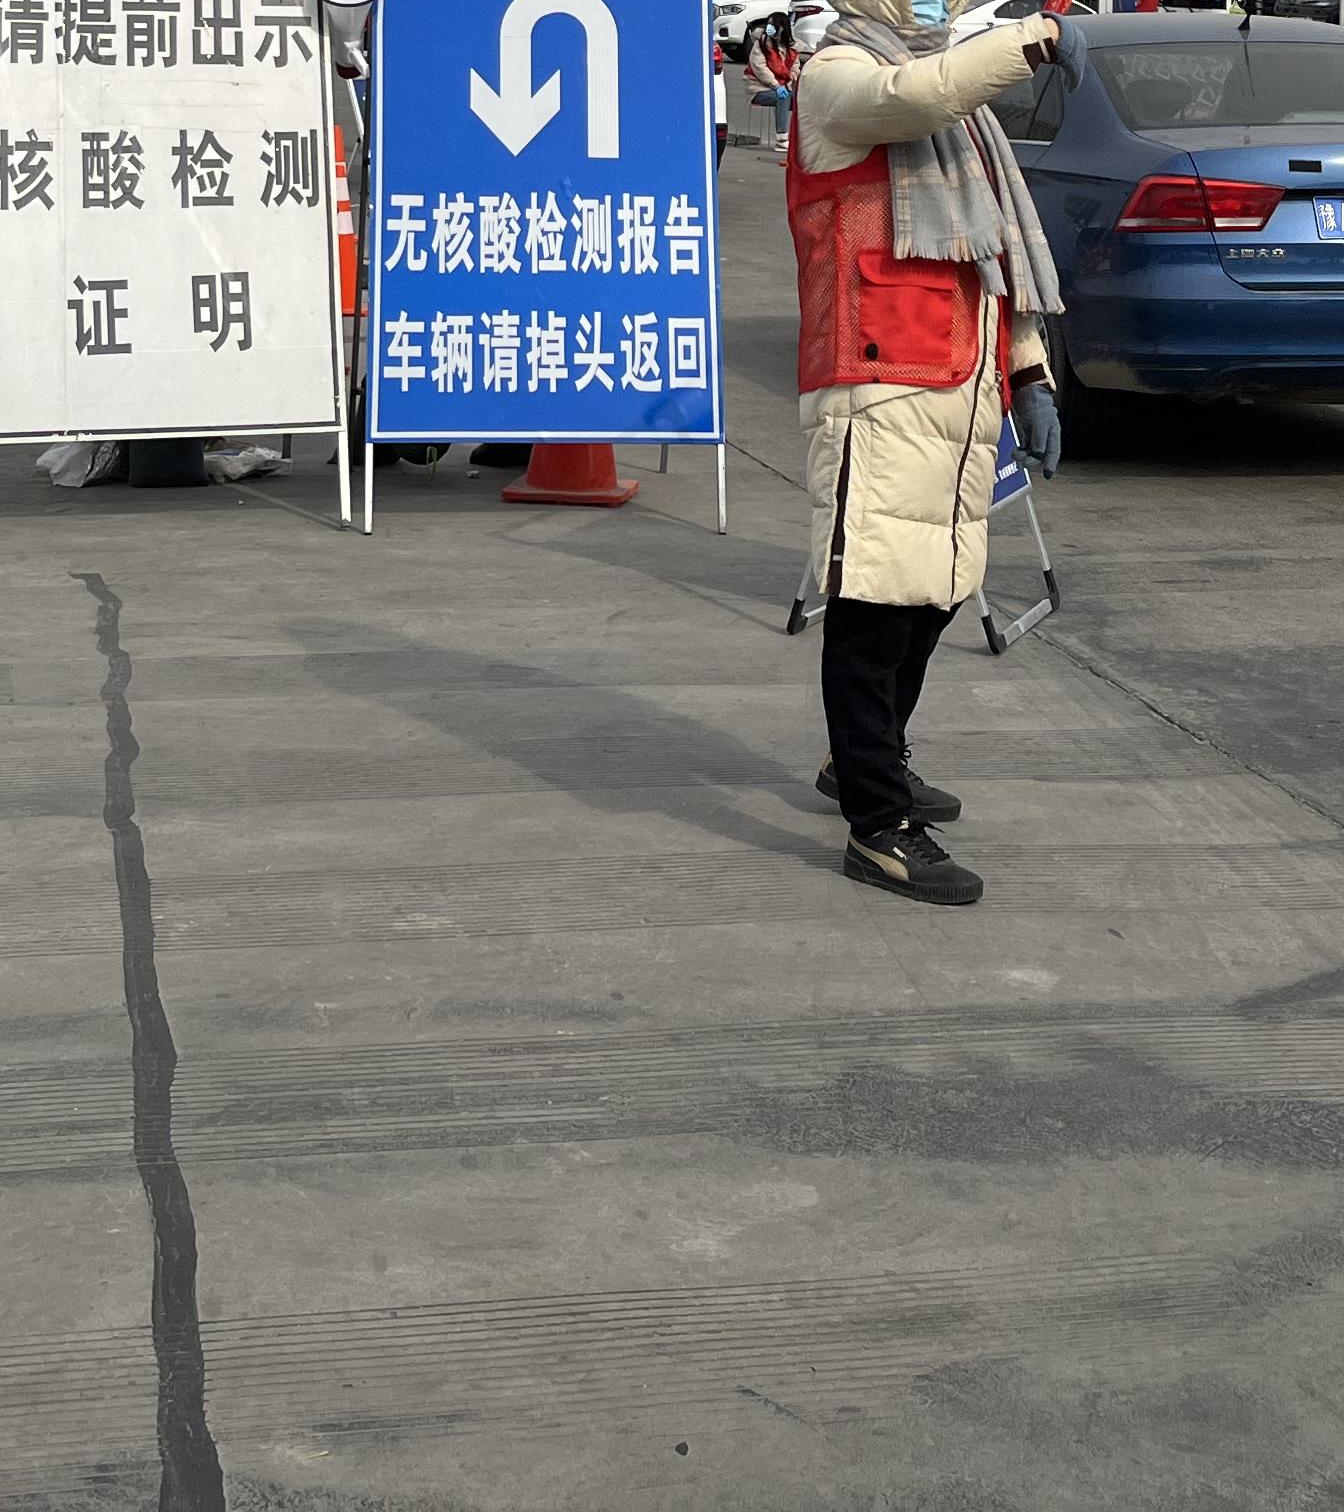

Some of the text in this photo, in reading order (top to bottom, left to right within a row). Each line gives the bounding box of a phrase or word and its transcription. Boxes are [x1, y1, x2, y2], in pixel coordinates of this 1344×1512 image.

[384, 191, 704, 275] 无核酸检测报告
[67, 271, 253, 356] 证明
[384, 309, 709, 394] 车辆请掉头返回
